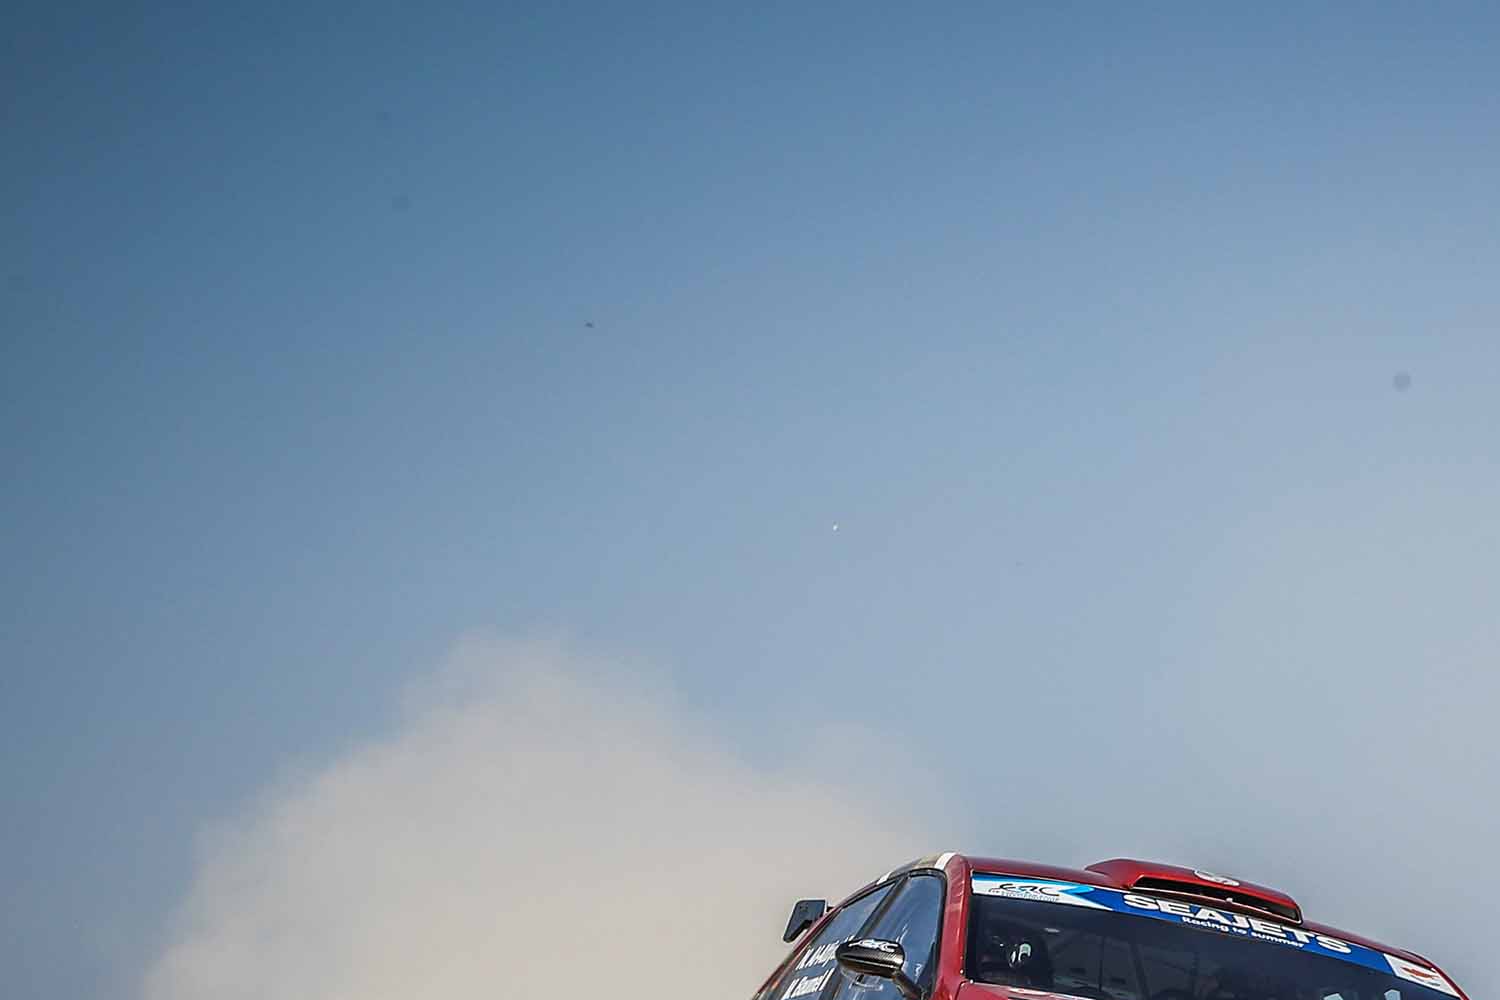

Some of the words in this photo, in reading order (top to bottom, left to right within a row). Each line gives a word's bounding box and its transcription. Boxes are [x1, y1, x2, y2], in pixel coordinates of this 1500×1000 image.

[1122, 892, 1351, 954] SEAJETS
[1181, 915, 1229, 932] Racing
[1250, 931, 1305, 947] summer
